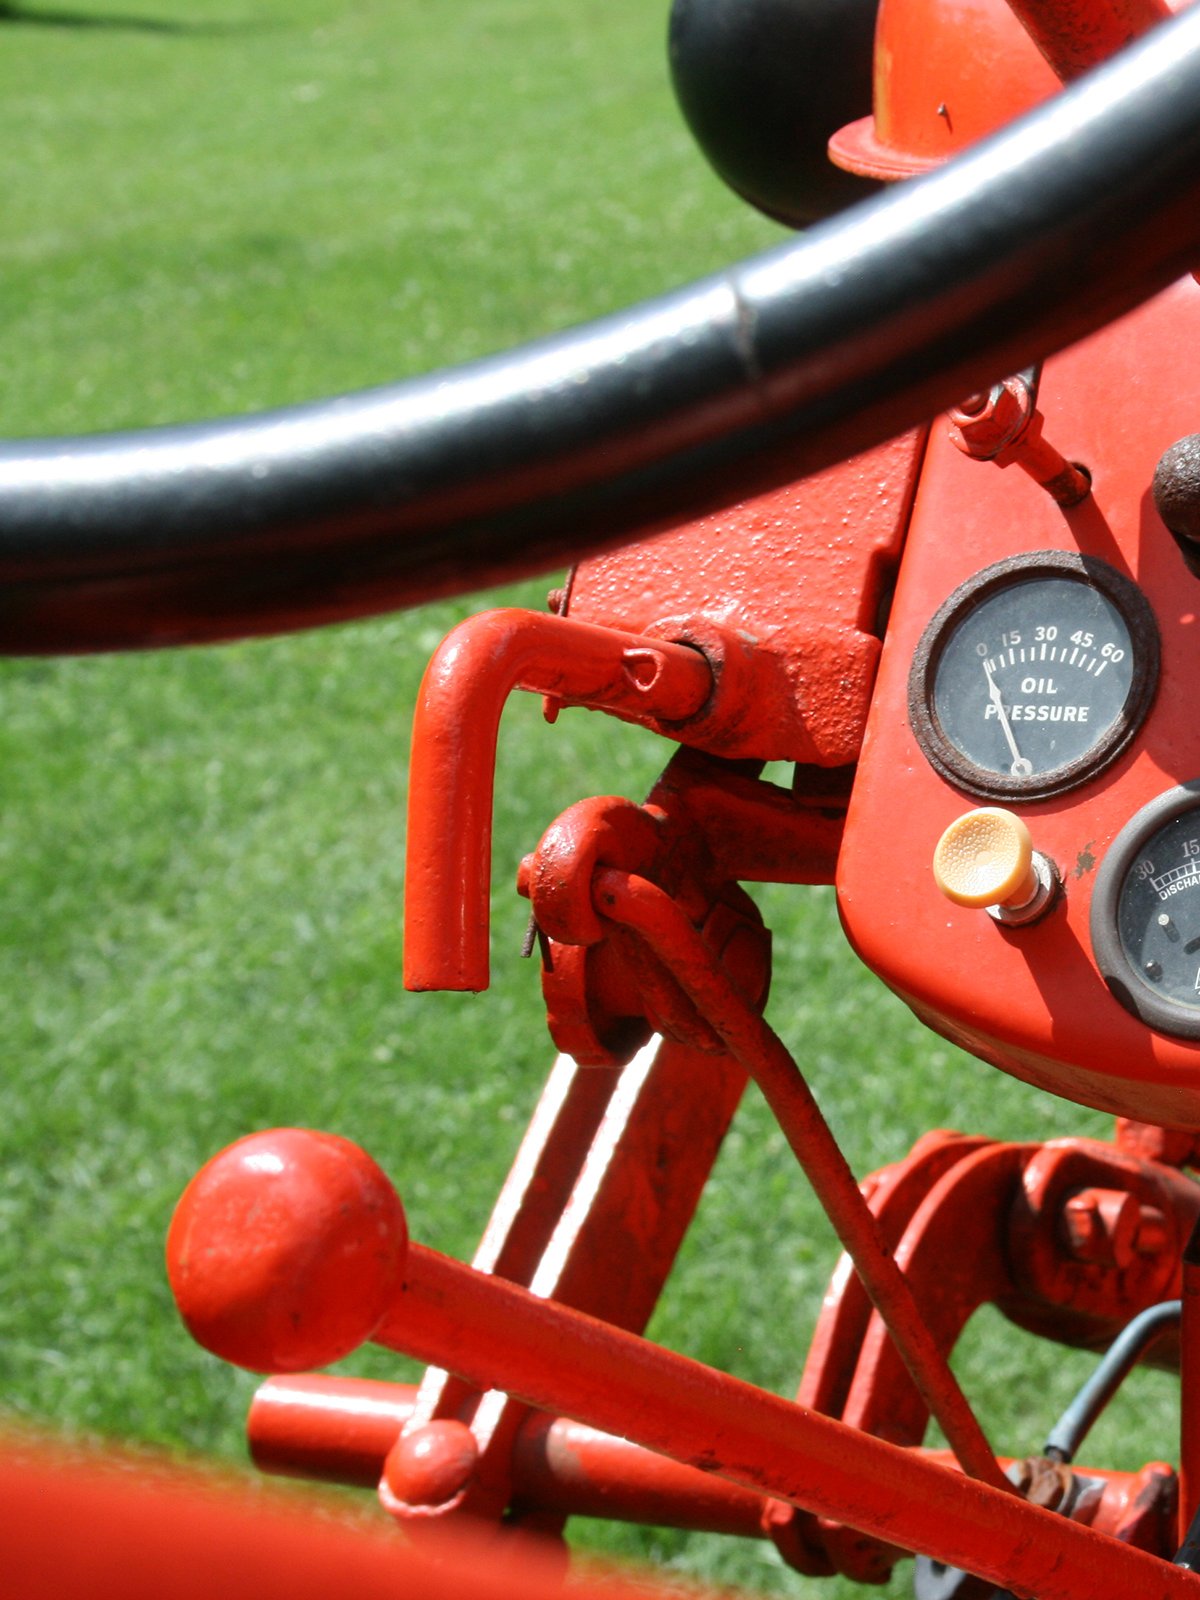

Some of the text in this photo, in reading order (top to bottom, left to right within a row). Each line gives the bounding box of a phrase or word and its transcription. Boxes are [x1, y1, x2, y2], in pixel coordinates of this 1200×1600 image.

[976, 626, 1124, 663] 0 15 30 45 60
[1021, 677, 1058, 694] OIL
[1134, 860, 1155, 880] 30
[1181, 839, 1200, 857] 15
